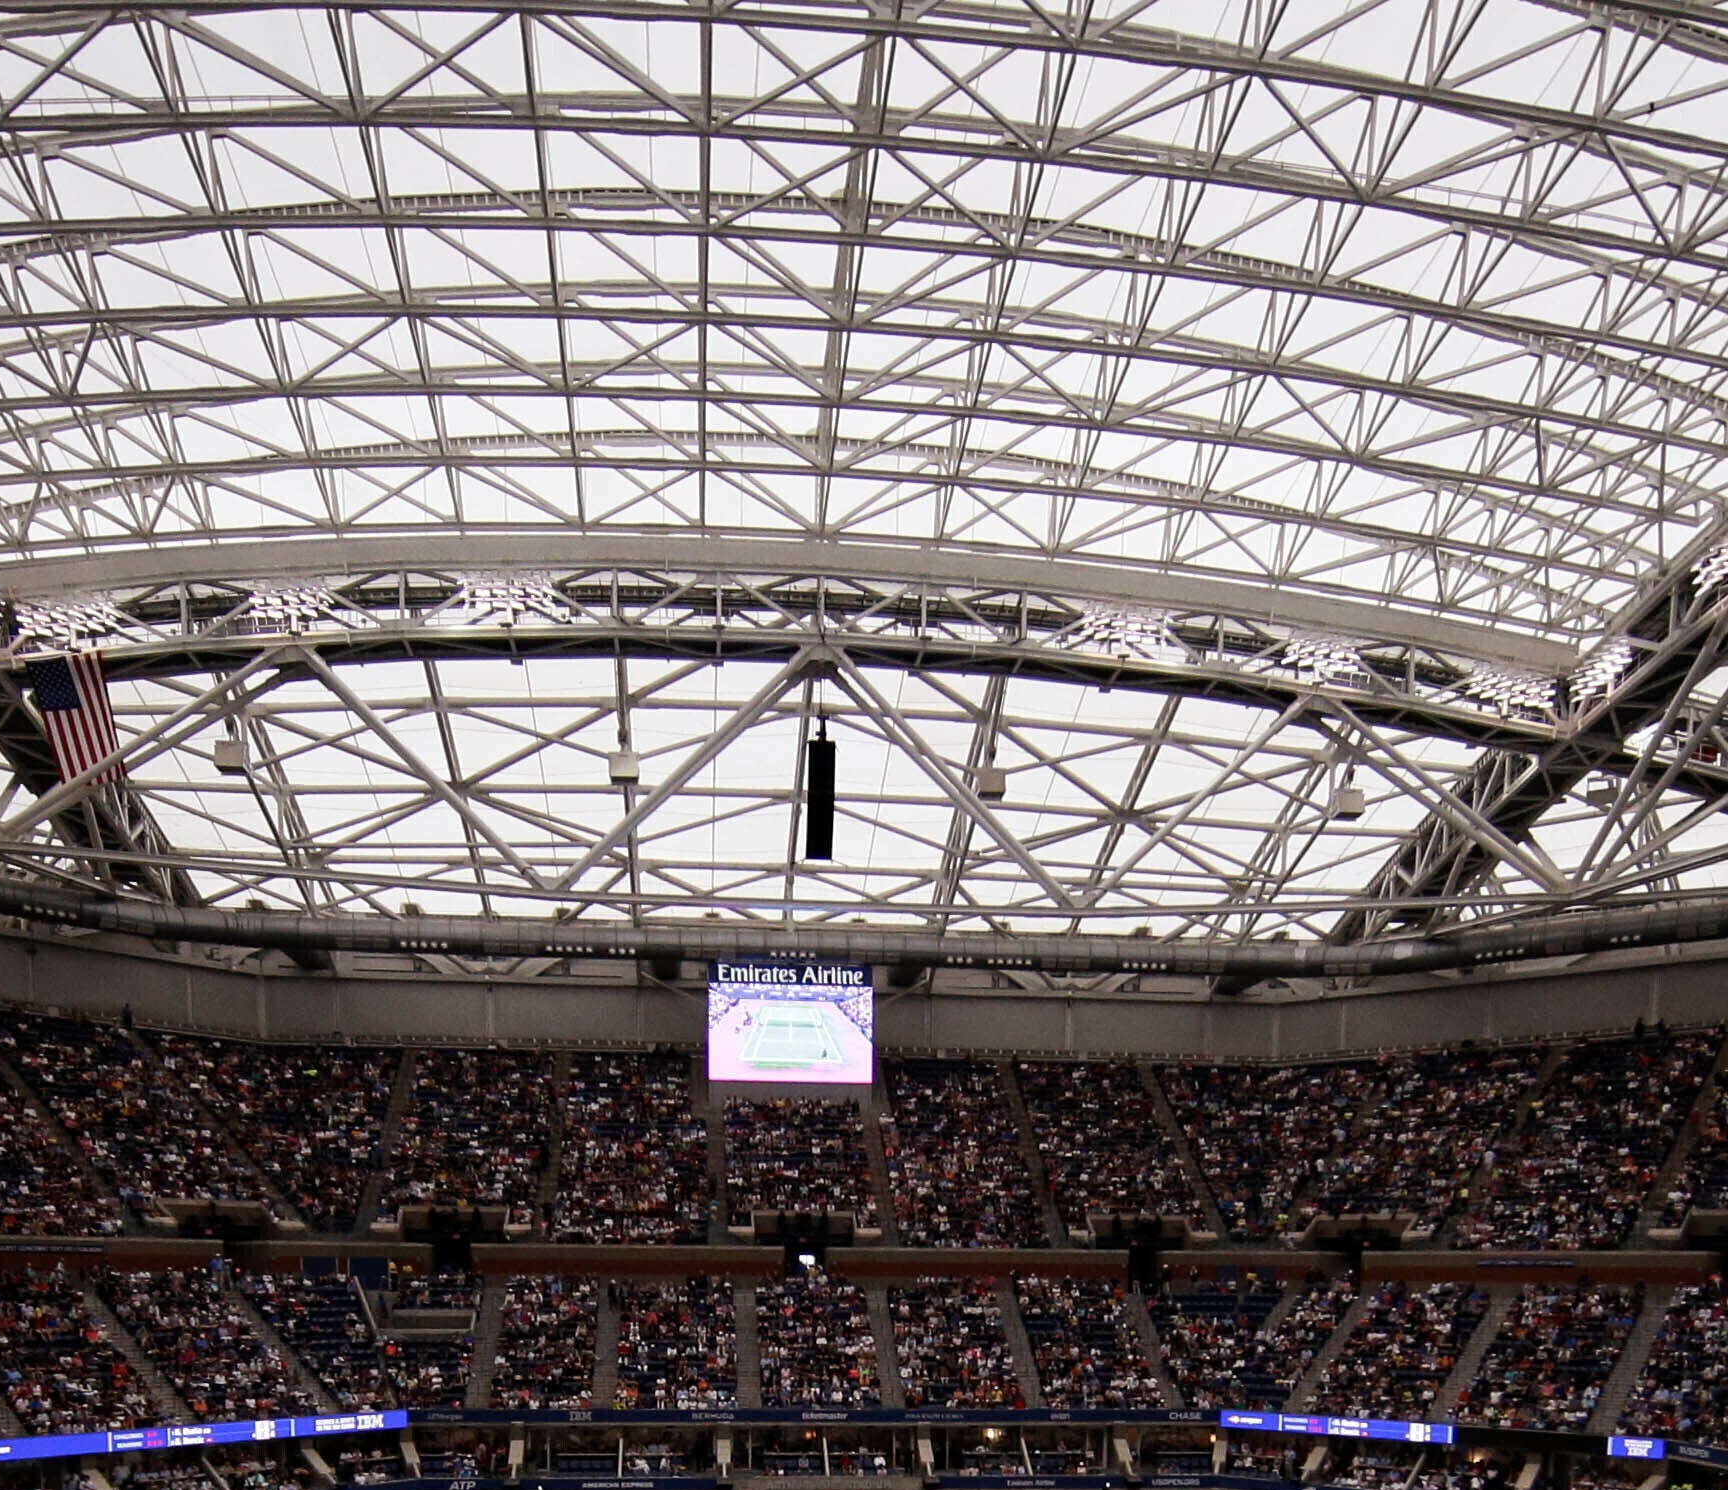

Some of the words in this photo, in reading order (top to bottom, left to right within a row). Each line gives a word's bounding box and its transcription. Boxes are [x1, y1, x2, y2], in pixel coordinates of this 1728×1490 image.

[717, 963, 798, 982] Emirates
[803, 965, 864, 985] Airline
[569, 1411, 592, 1421] IBM
[1168, 1411, 1202, 1420] CHASE
[356, 1414, 384, 1430] IBM
[449, 1480, 476, 1490] ATP
